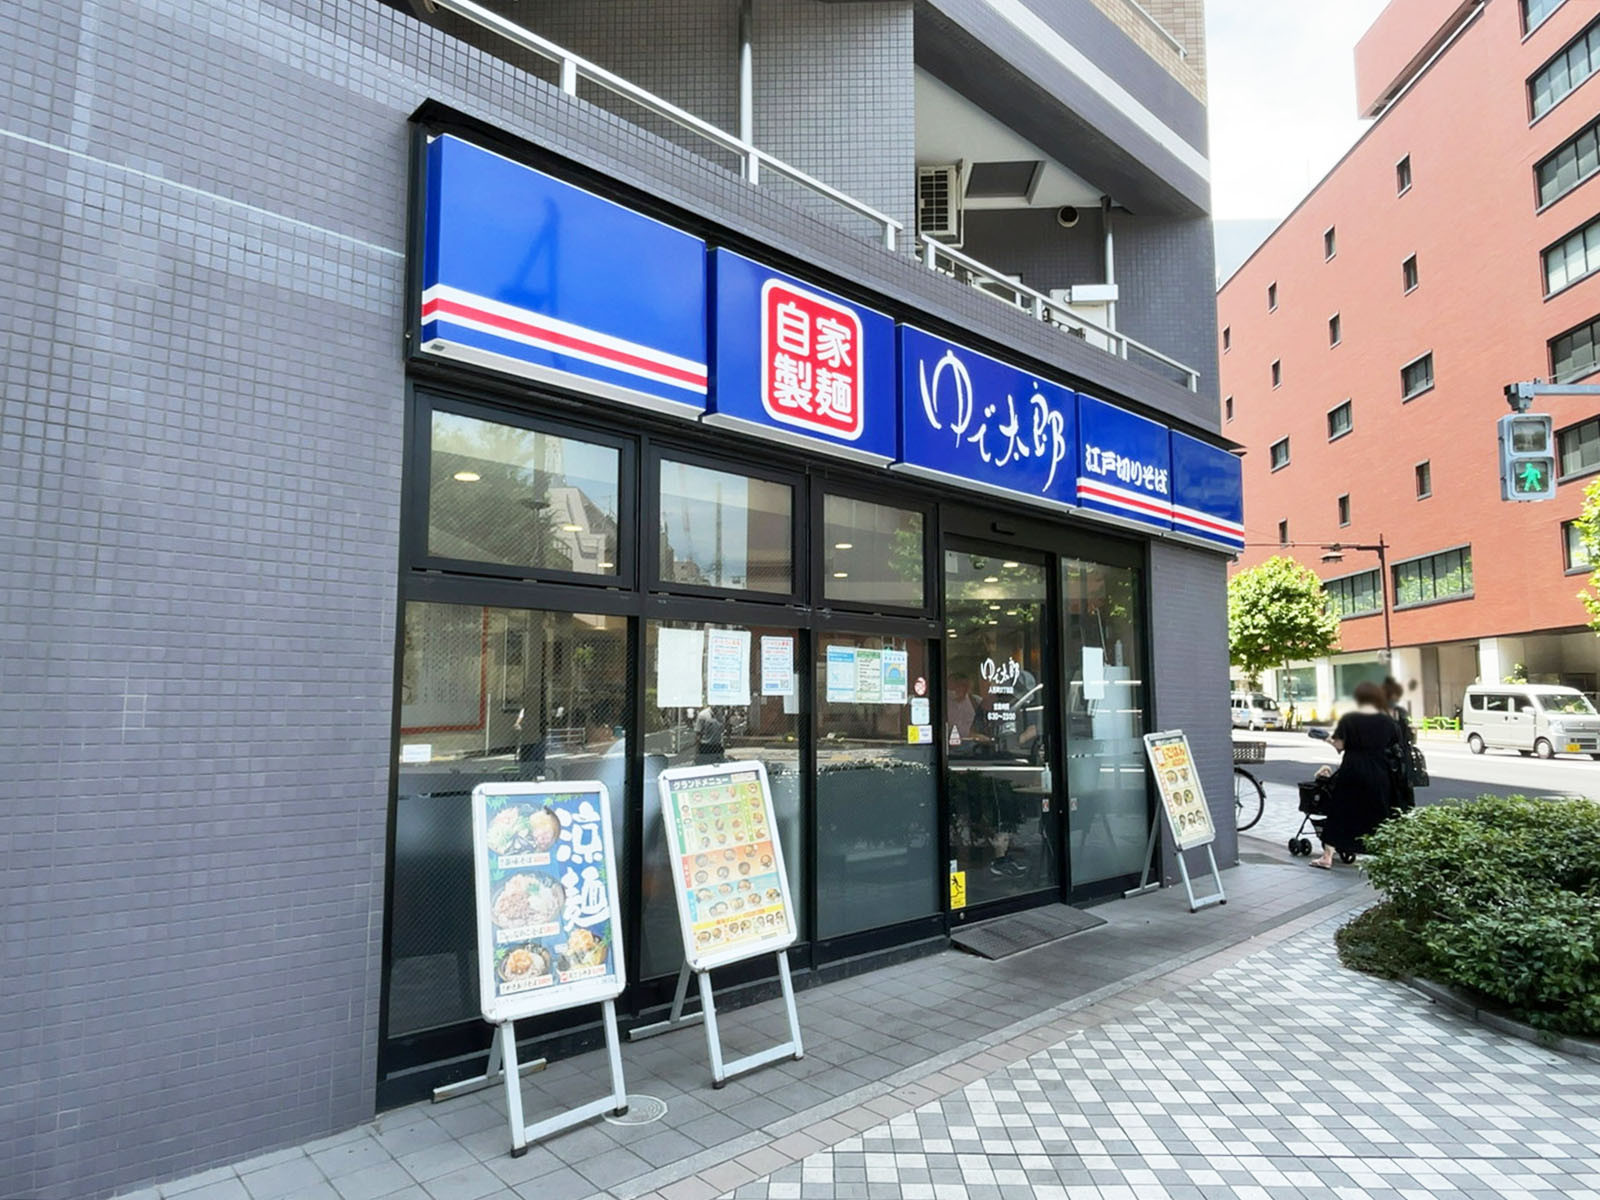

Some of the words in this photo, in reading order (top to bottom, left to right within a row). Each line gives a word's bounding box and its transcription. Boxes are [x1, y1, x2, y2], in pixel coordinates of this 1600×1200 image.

[775, 302, 852, 368] 自家
[773, 355, 853, 424] 製麺
[918, 349, 1066, 493] ゆで太郎
[1085, 443, 1168, 495] 江戸切りそば
[673, 777, 729, 790] グランドメニュー
[556, 801, 611, 932] 涼麺
